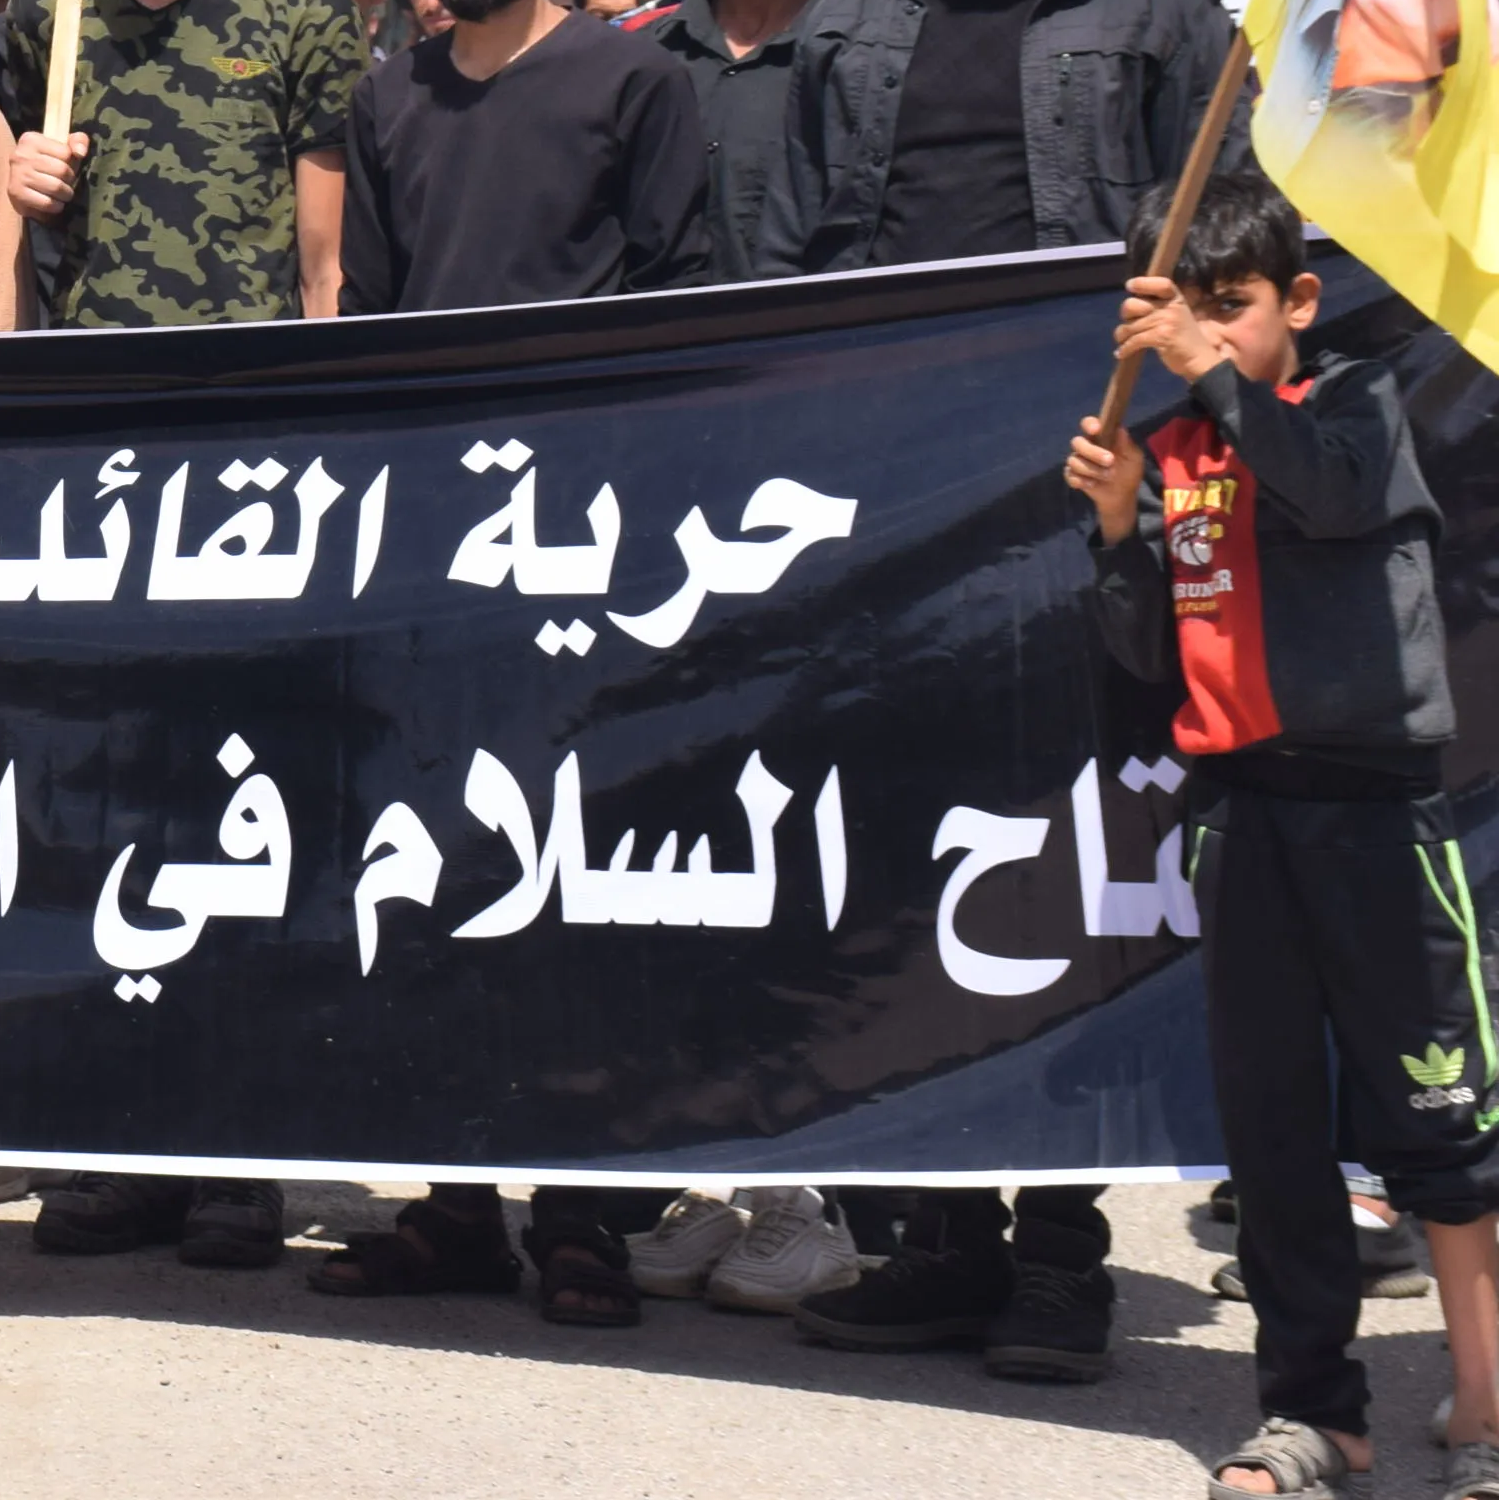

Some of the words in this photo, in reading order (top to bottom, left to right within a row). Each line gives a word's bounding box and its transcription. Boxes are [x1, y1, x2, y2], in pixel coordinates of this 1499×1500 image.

[447, 439, 859, 657] حرية
[92, 732, 292, 1004] في
[353, 747, 847, 977] السلام
[931, 756, 1201, 997] تاح
